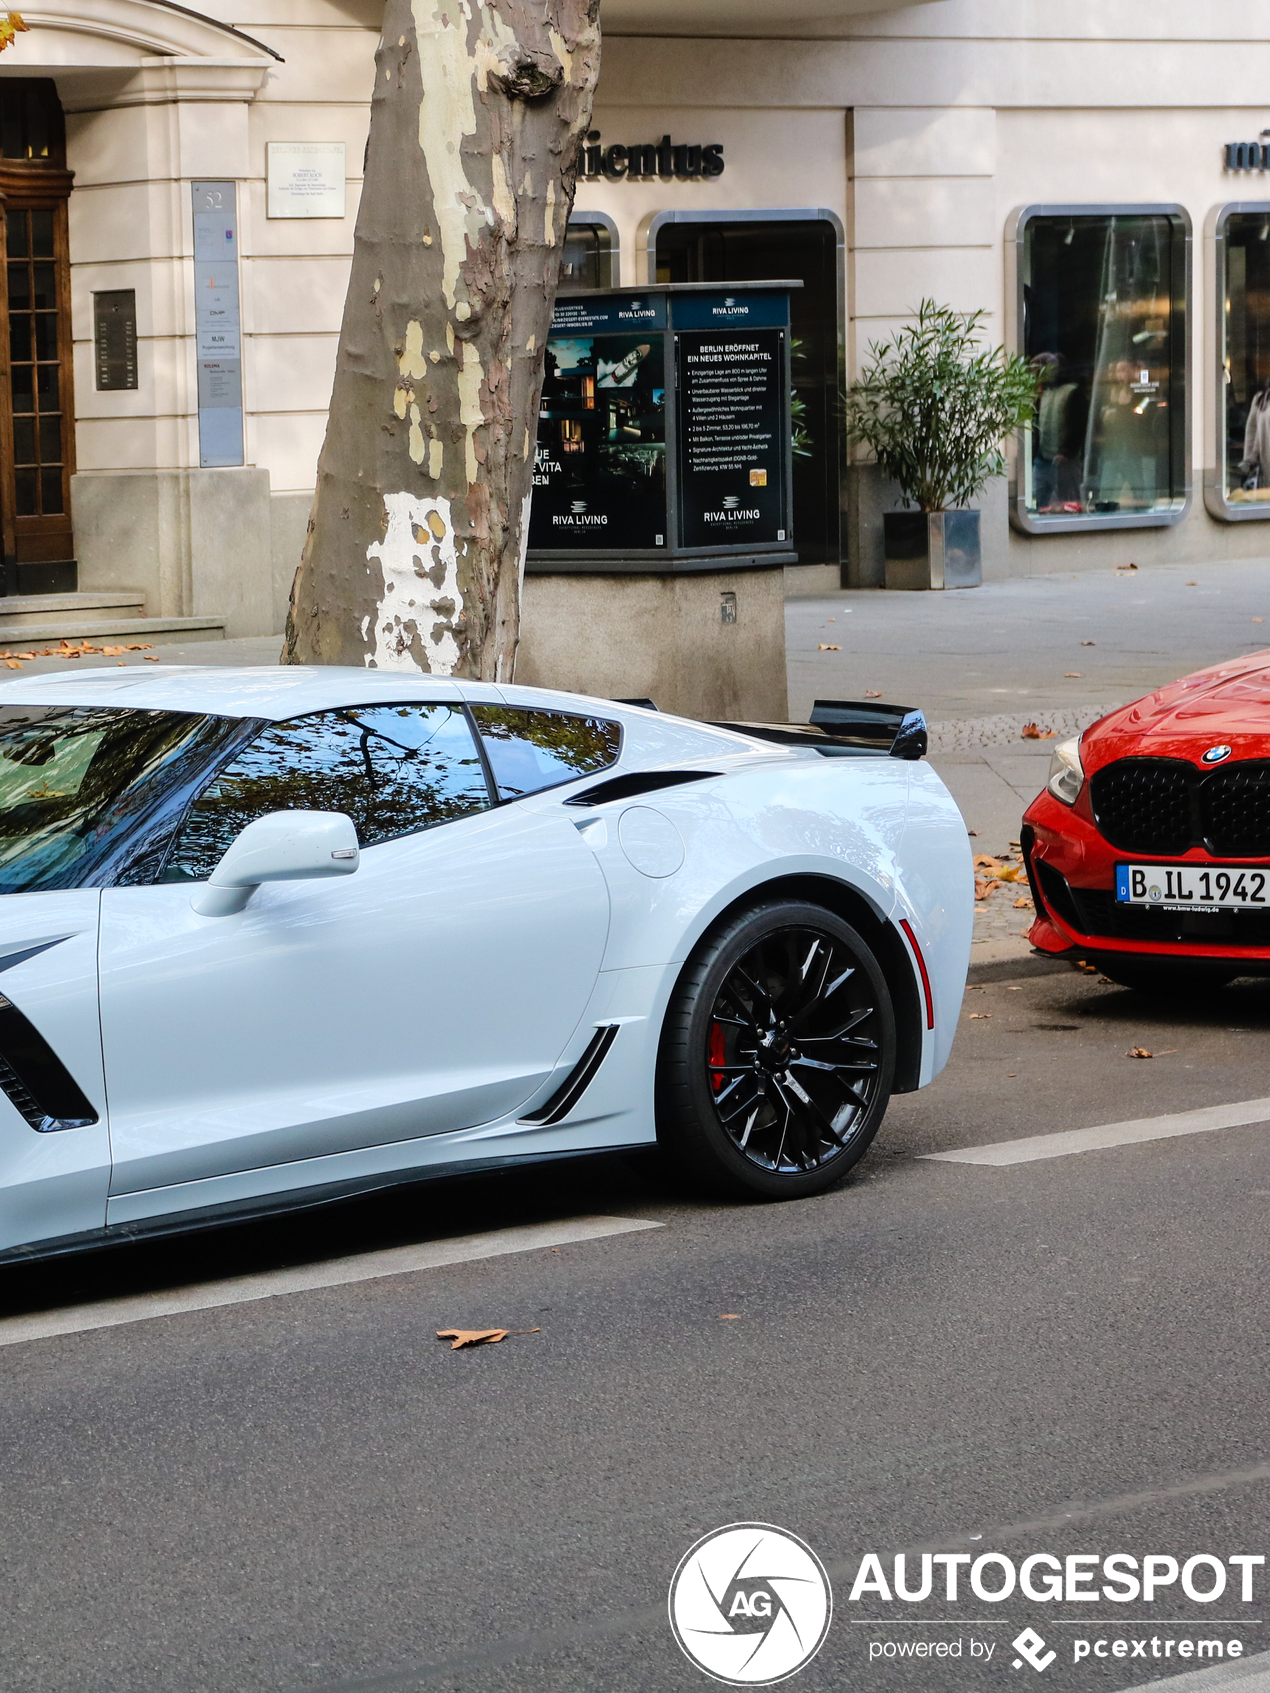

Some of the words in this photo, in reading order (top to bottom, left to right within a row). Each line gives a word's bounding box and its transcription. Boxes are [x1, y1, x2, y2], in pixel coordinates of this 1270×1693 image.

[577, 130, 725, 177] ientus
[206, 191, 222, 208] 52
[700, 345, 723, 353] BERLIN
[725, 344, 760, 352] ERÖFFNET
[723, 353, 772, 362] WOHNKAPITEL
[539, 462, 562, 472] VITA
[552, 516, 574, 525] RIVA
[576, 515, 608, 524] LIVING
[704, 512, 726, 522] RIVA
[728, 509, 760, 520] LIVING
[1132, 870, 1147, 898] B
[1164, 871, 1193, 899] IL
[1199, 872, 1266, 902] 1942
[1163, 905, 1219, 913] www.bmw-ludwig.de
